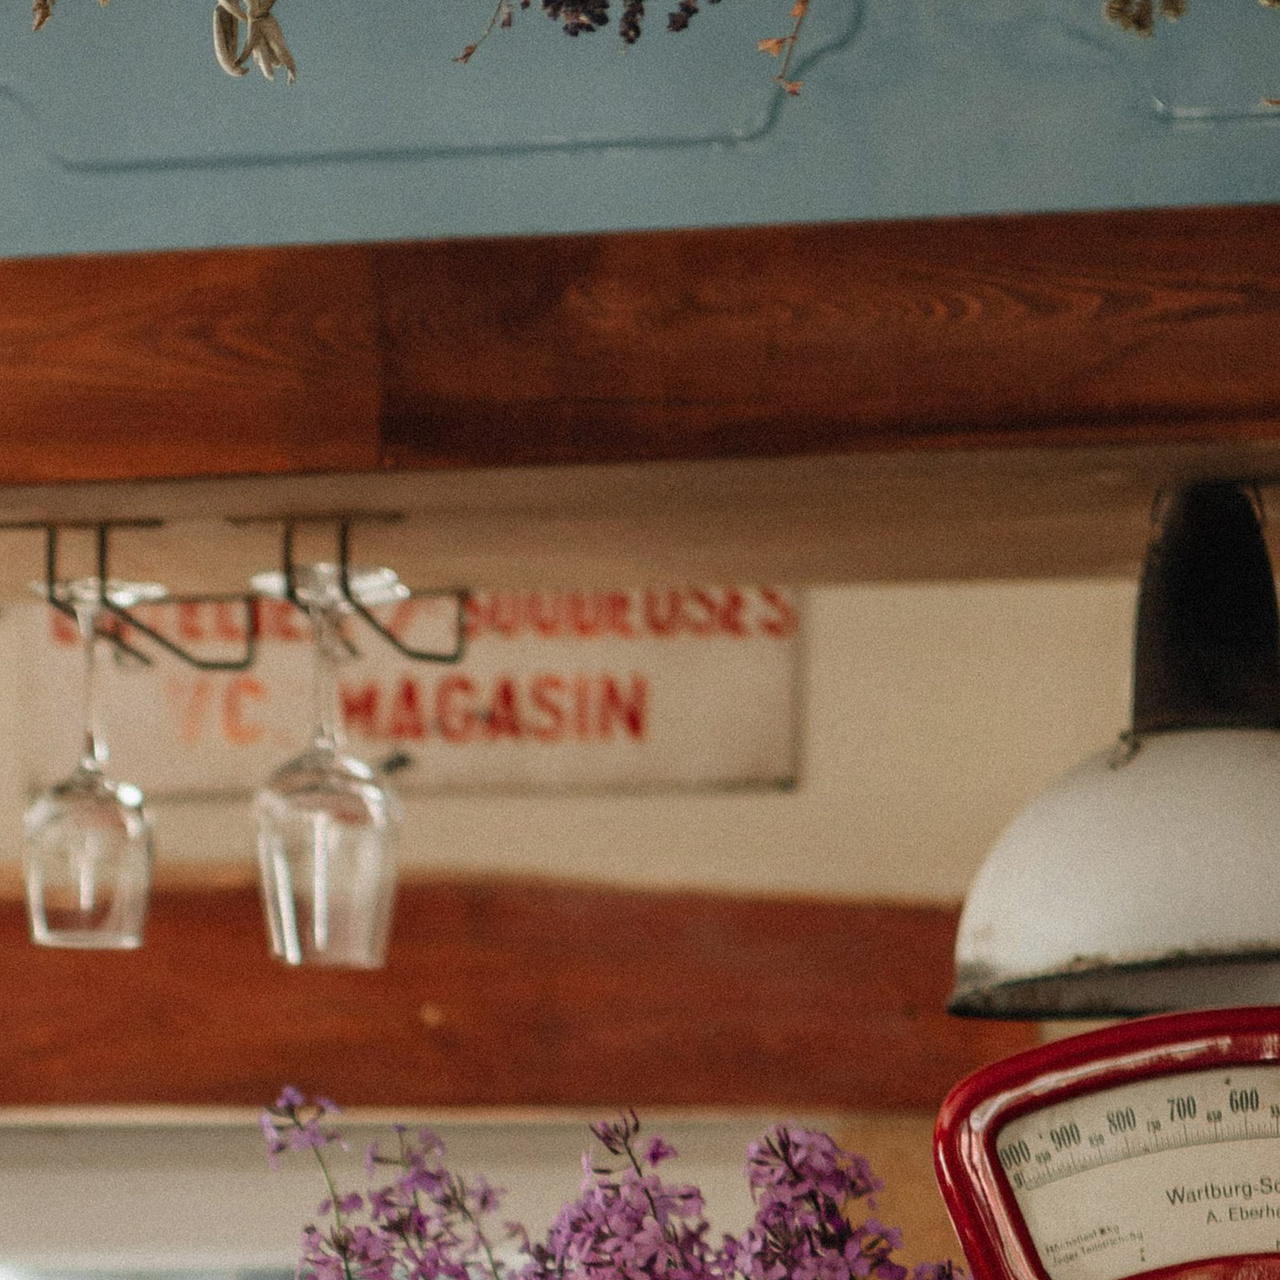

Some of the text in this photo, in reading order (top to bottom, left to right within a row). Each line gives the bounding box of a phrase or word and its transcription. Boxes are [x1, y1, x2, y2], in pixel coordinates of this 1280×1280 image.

[337, 674, 651, 745] MAGASIN
[1000, 1139, 1031, 1171] 000
[1050, 1122, 1081, 1152] 900
[1106, 1106, 1137, 1136] 800
[1167, 1095, 1197, 1123] 700
[1229, 1087, 1260, 1113] 600
[1206, 1209, 1222, 1225] A.
